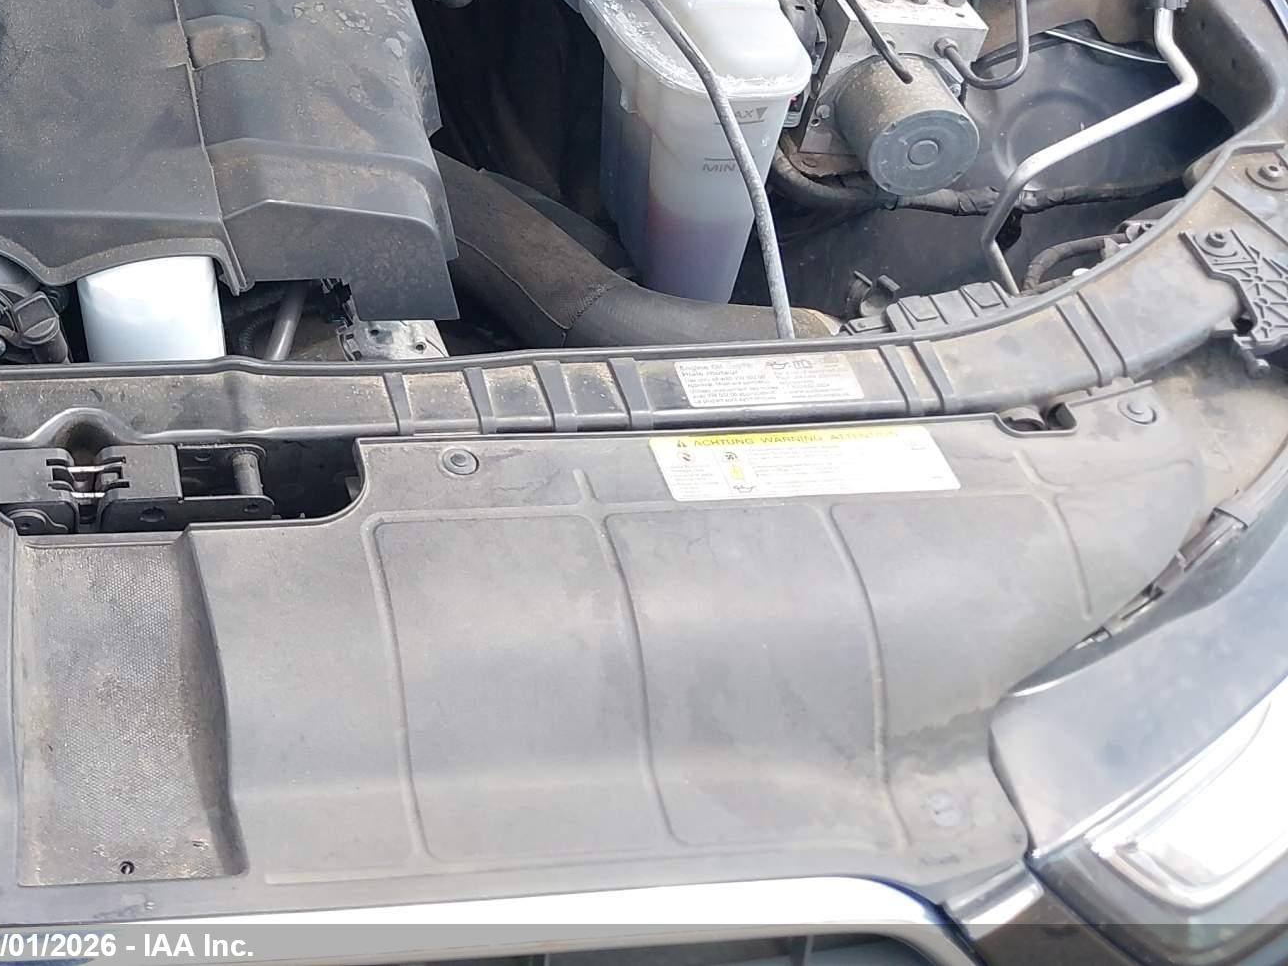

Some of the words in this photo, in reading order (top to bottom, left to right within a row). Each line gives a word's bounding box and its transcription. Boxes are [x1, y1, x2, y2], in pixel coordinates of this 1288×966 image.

[702, 163, 737, 173] MIN
[694, 439, 754, 447] ACHTUNG
[762, 436, 823, 444] WARNING
